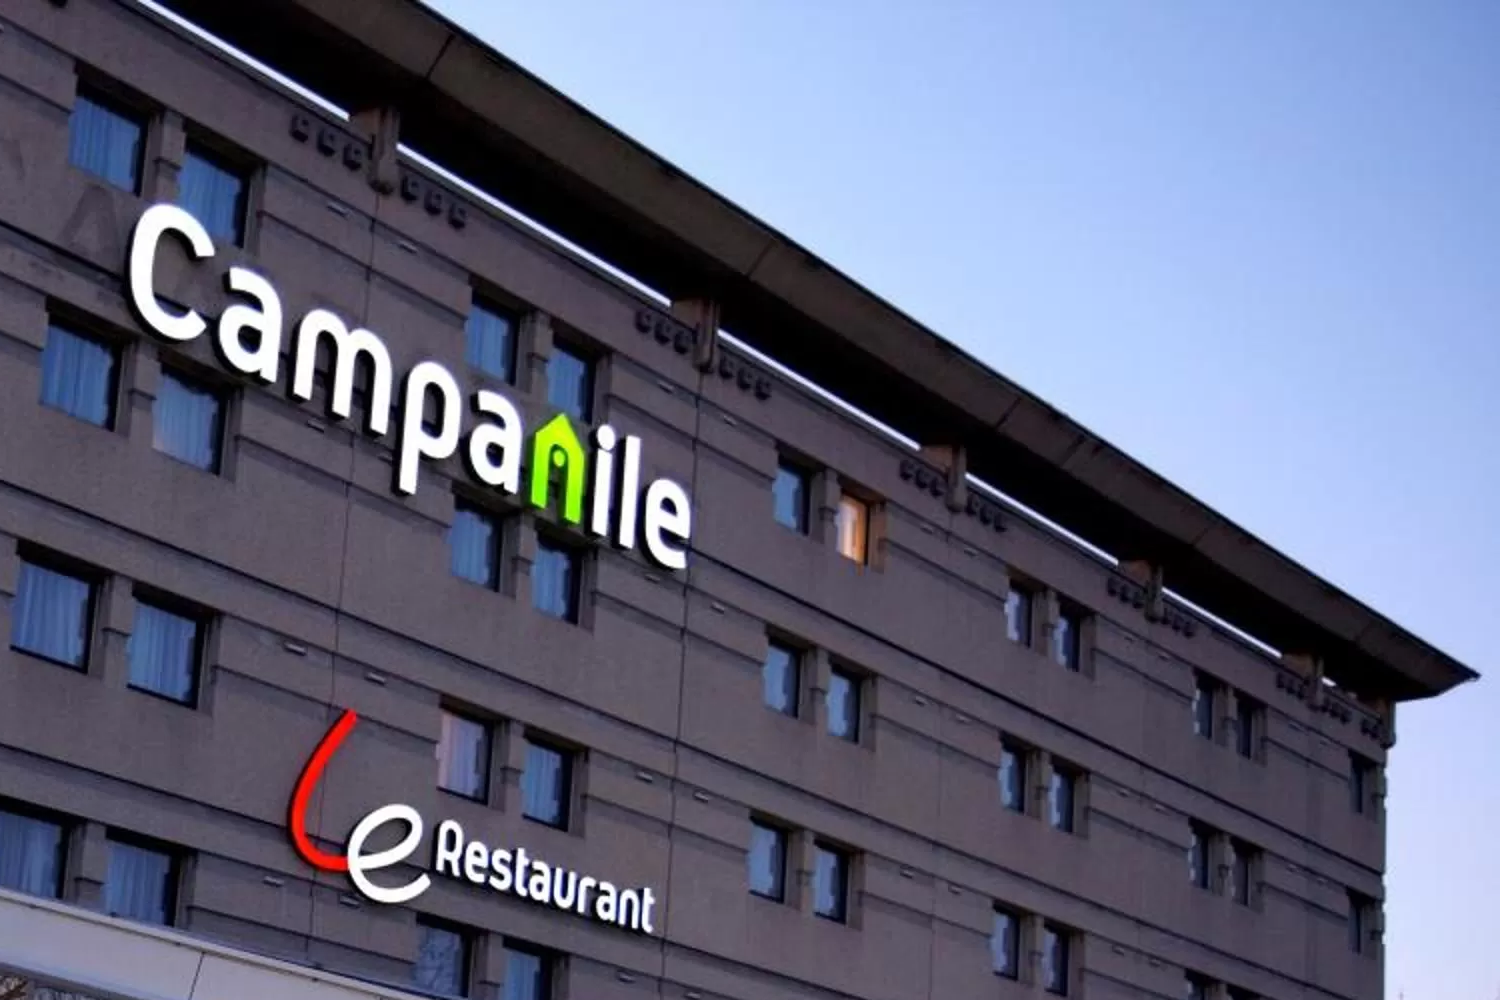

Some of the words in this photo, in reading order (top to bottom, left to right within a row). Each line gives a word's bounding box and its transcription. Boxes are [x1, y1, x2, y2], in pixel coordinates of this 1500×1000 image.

[129, 203, 691, 570] Campanile
[290, 710, 430, 903] Le
[436, 819, 653, 932] Restaurant
